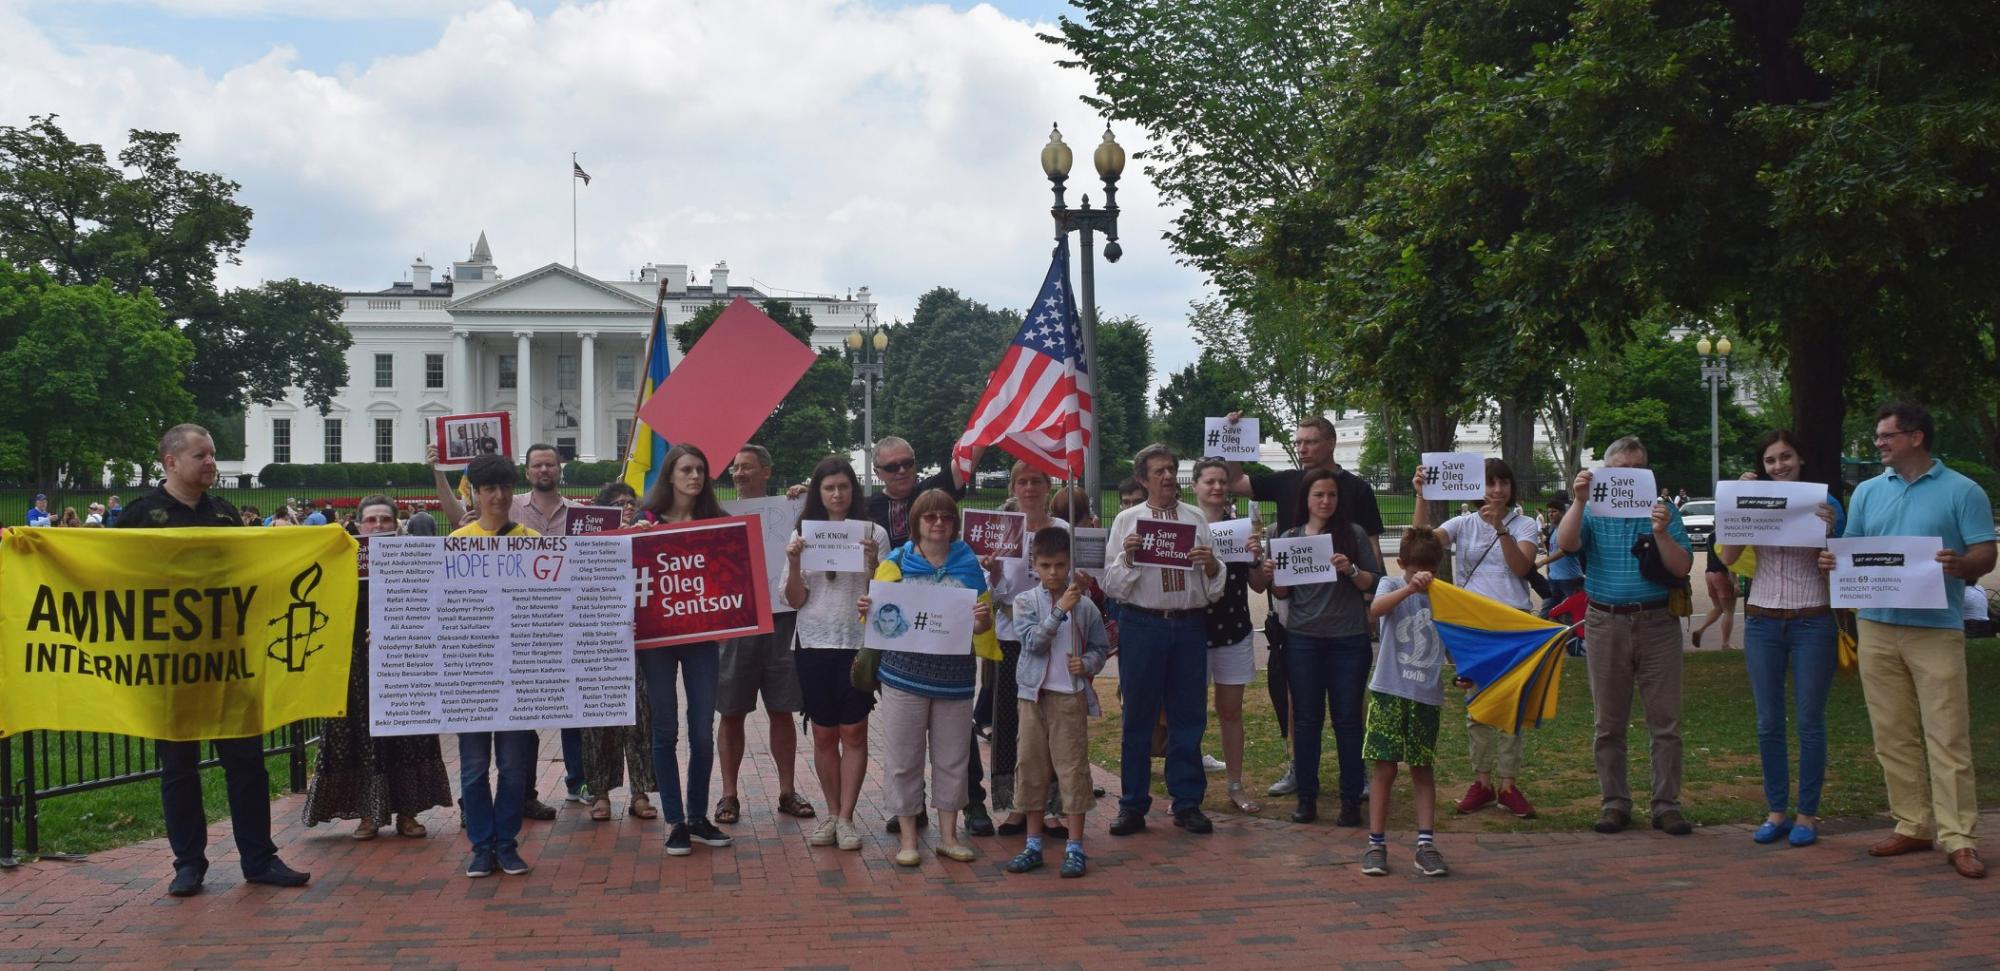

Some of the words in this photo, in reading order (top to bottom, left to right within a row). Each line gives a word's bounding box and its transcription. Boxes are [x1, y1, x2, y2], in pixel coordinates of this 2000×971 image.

[1223, 426, 1241, 434] Save
[1222, 435, 1240, 444] Oleg
[1222, 444, 1255, 452] Sentsov
[1442, 461, 1465, 470] Save
[1442, 472, 1463, 482] Oleg
[1611, 477, 1635, 486] Save
[1442, 482, 1480, 491] Sentsov
[1611, 488, 1633, 499] Oleg
[1611, 499, 1652, 508] Sentsov
[586, 515, 603, 523] Save
[986, 521, 1005, 531] Save
[985, 531, 1004, 540] Oleg
[1158, 529, 1177, 539] Save
[1212, 529, 1233, 538] Save
[444, 537, 500, 551] KREMLIN
[507, 537, 567, 551] HOSTAGES
[984, 540, 1018, 549] Sentsov
[1156, 539, 1175, 549] Oleg
[1155, 548, 1188, 559] Sentsov
[1290, 546, 1313, 554] Save
[657, 553, 705, 573] Save
[1292, 556, 1313, 565] Oleg
[446, 554, 490, 579] HOPE
[497, 554, 526, 578] FOR
[534, 555, 564, 582] G7
[1293, 565, 1330, 574] Sentsov
[660, 575, 705, 596] Oleg
[662, 594, 743, 617] Sentsov
[26, 584, 259, 643] AMNESTY
[25, 642, 256, 686] INTERNATIONAL
[1402, 669, 1426, 682] КИЇВ
